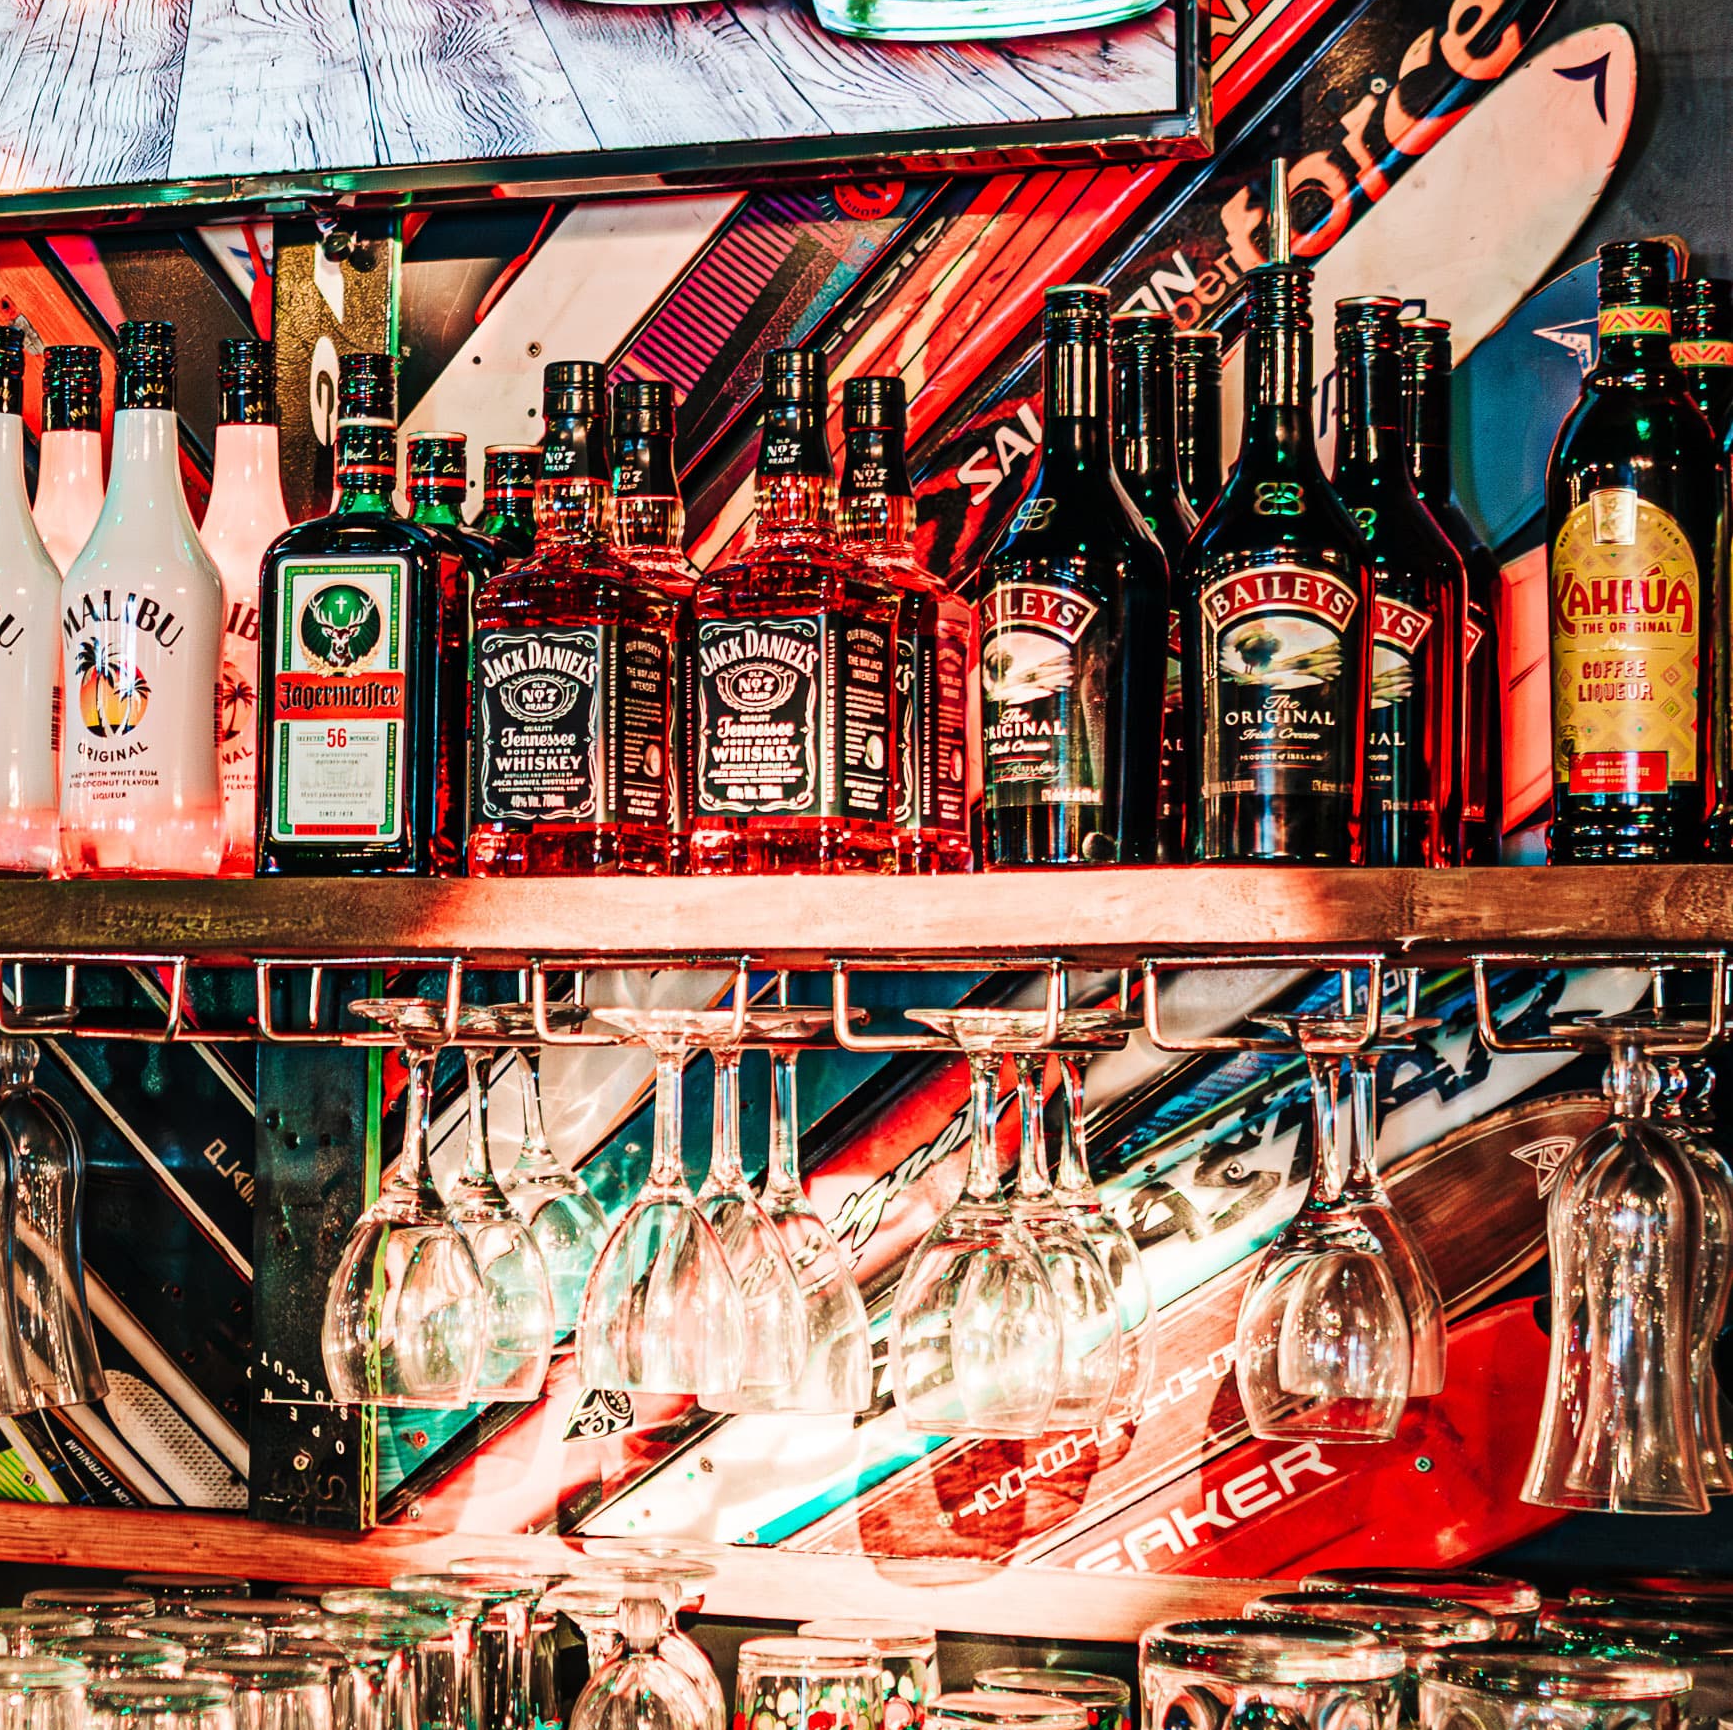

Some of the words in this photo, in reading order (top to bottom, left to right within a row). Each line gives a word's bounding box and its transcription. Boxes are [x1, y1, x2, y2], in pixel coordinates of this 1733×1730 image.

[1215, 579, 1351, 617] BAILEYS
[1553, 566, 1693, 635] KAHLÚA
[981, 591, 1080, 630] AILEYS
[1582, 623, 1604, 633] THE
[1609, 621, 1672, 633] ORGINAL
[700, 639, 744, 676] JACK
[745, 629, 819, 677] DANIEL'S
[482, 648, 525, 687] JACK
[527, 642, 599, 687] DANIEL'S
[1582, 661, 1647, 678] COFFEE
[280, 682, 400, 711] Jägermeister
[1578, 684, 1654, 702] LIQUEUR
[1261, 696, 1299, 712] The
[717, 717, 794, 738] Tennessee
[1225, 709, 1335, 726] ORIGINAL
[327, 728, 347, 748] 56
[501, 728, 576, 748] Tennessee
[496, 756, 582, 771] WHISKEY
[712, 746, 800, 761] WHISKEY
